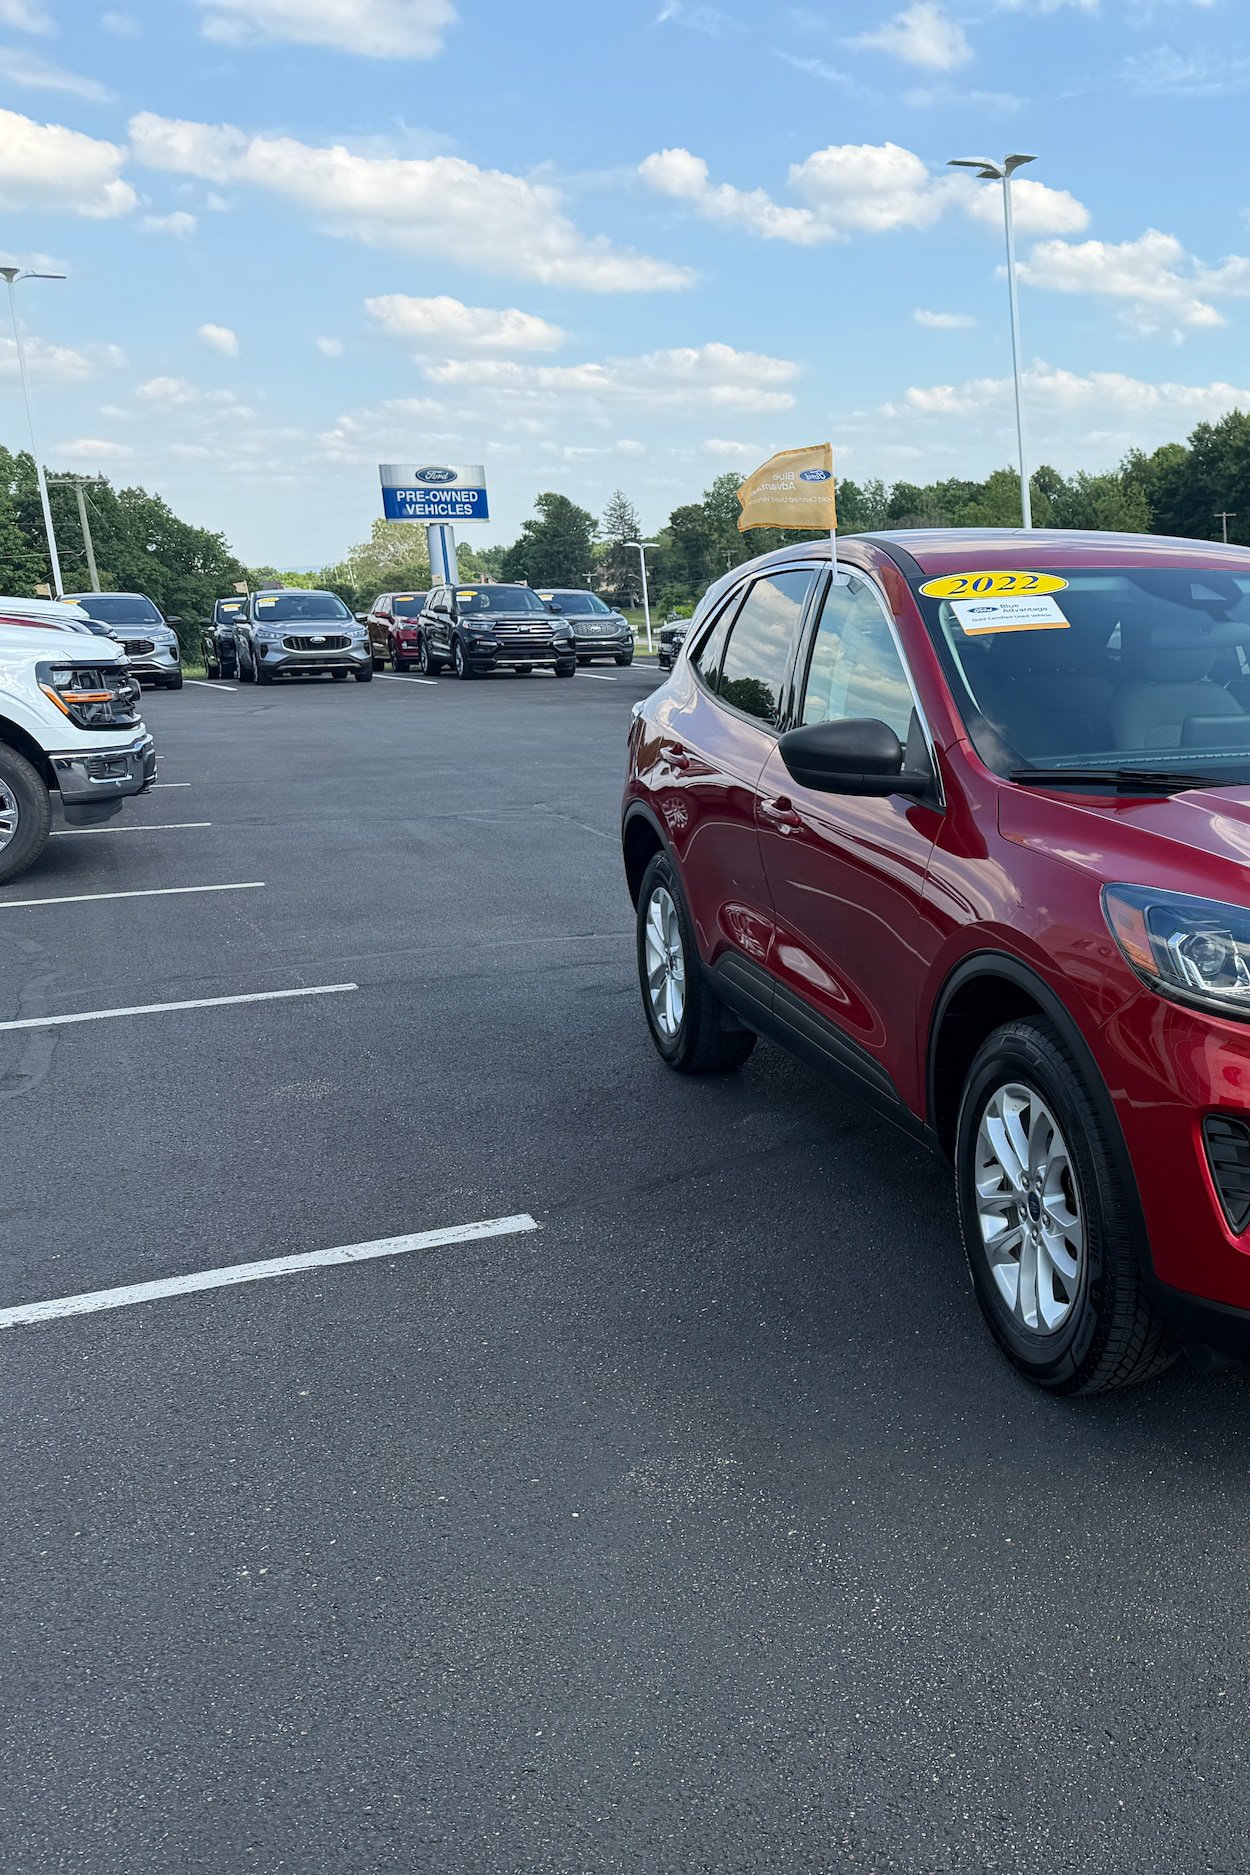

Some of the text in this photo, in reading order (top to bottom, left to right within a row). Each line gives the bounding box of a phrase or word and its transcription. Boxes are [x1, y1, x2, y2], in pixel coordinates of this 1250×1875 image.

[425, 470, 449, 480] Ford
[396, 490, 478, 502] PRE-OWNED
[405, 503, 473, 515] VEHICLES
[948, 575, 1039, 595] 2022
